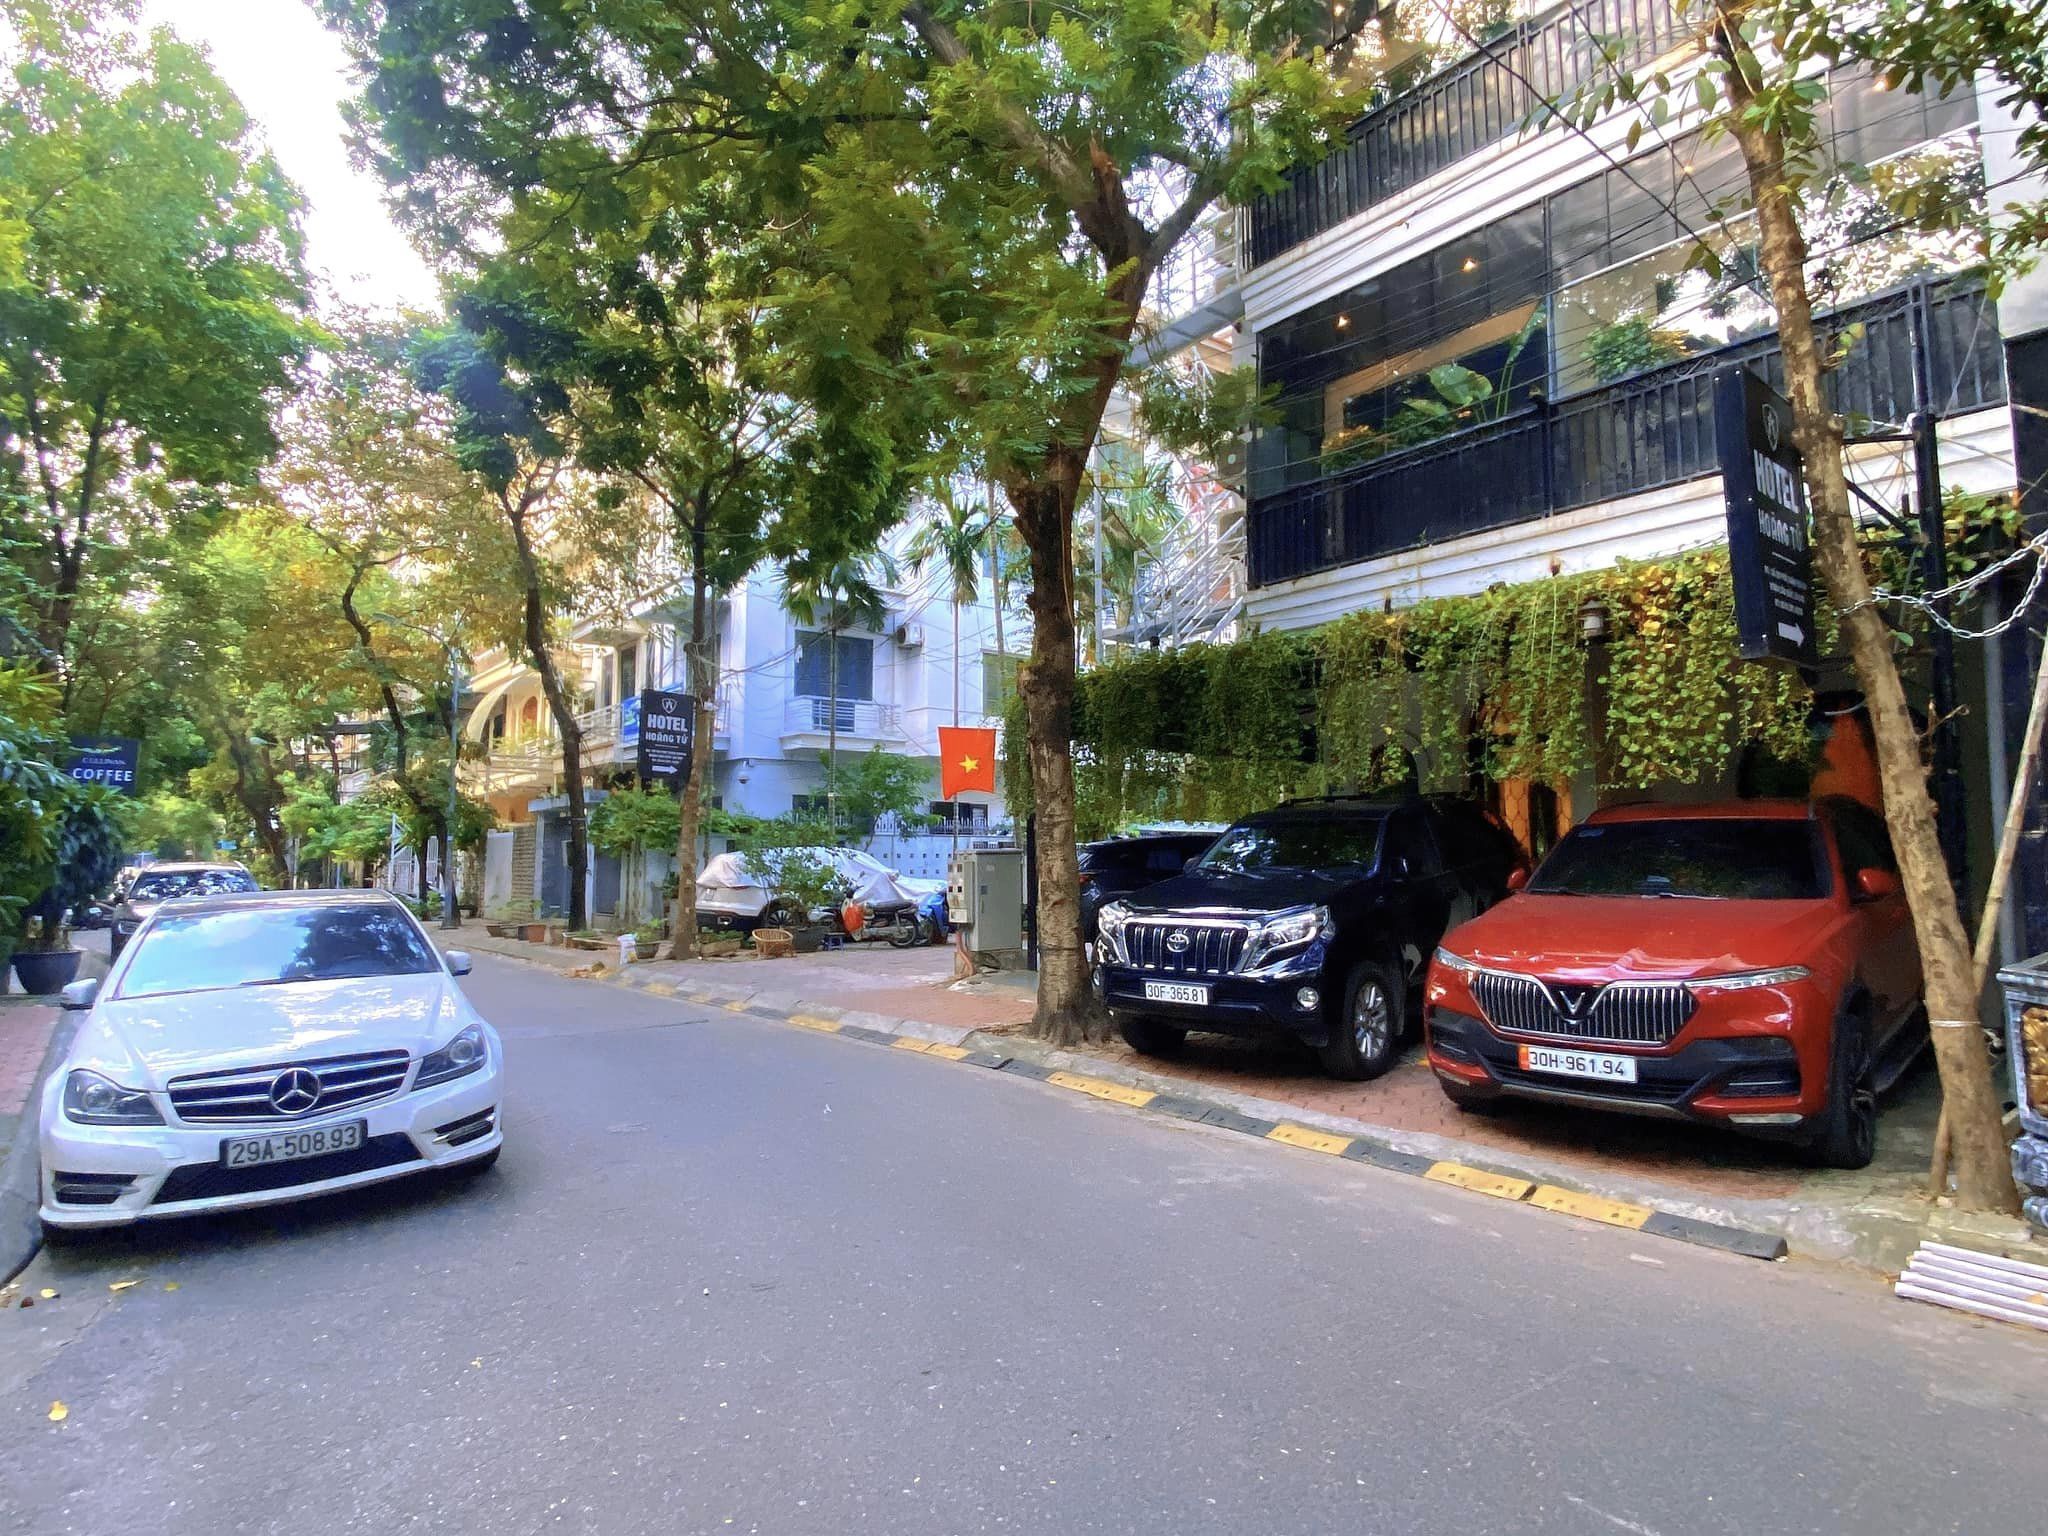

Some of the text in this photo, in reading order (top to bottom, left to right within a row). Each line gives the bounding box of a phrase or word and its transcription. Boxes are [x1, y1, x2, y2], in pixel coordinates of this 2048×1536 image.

[1753, 448, 1800, 514] HOTEL
[647, 713, 688, 732] HOTEL
[72, 768, 133, 782] COFFEE
[1529, 1051, 1625, 1077] 30H-961.94
[231, 1126, 357, 1165] 29A-508.93
